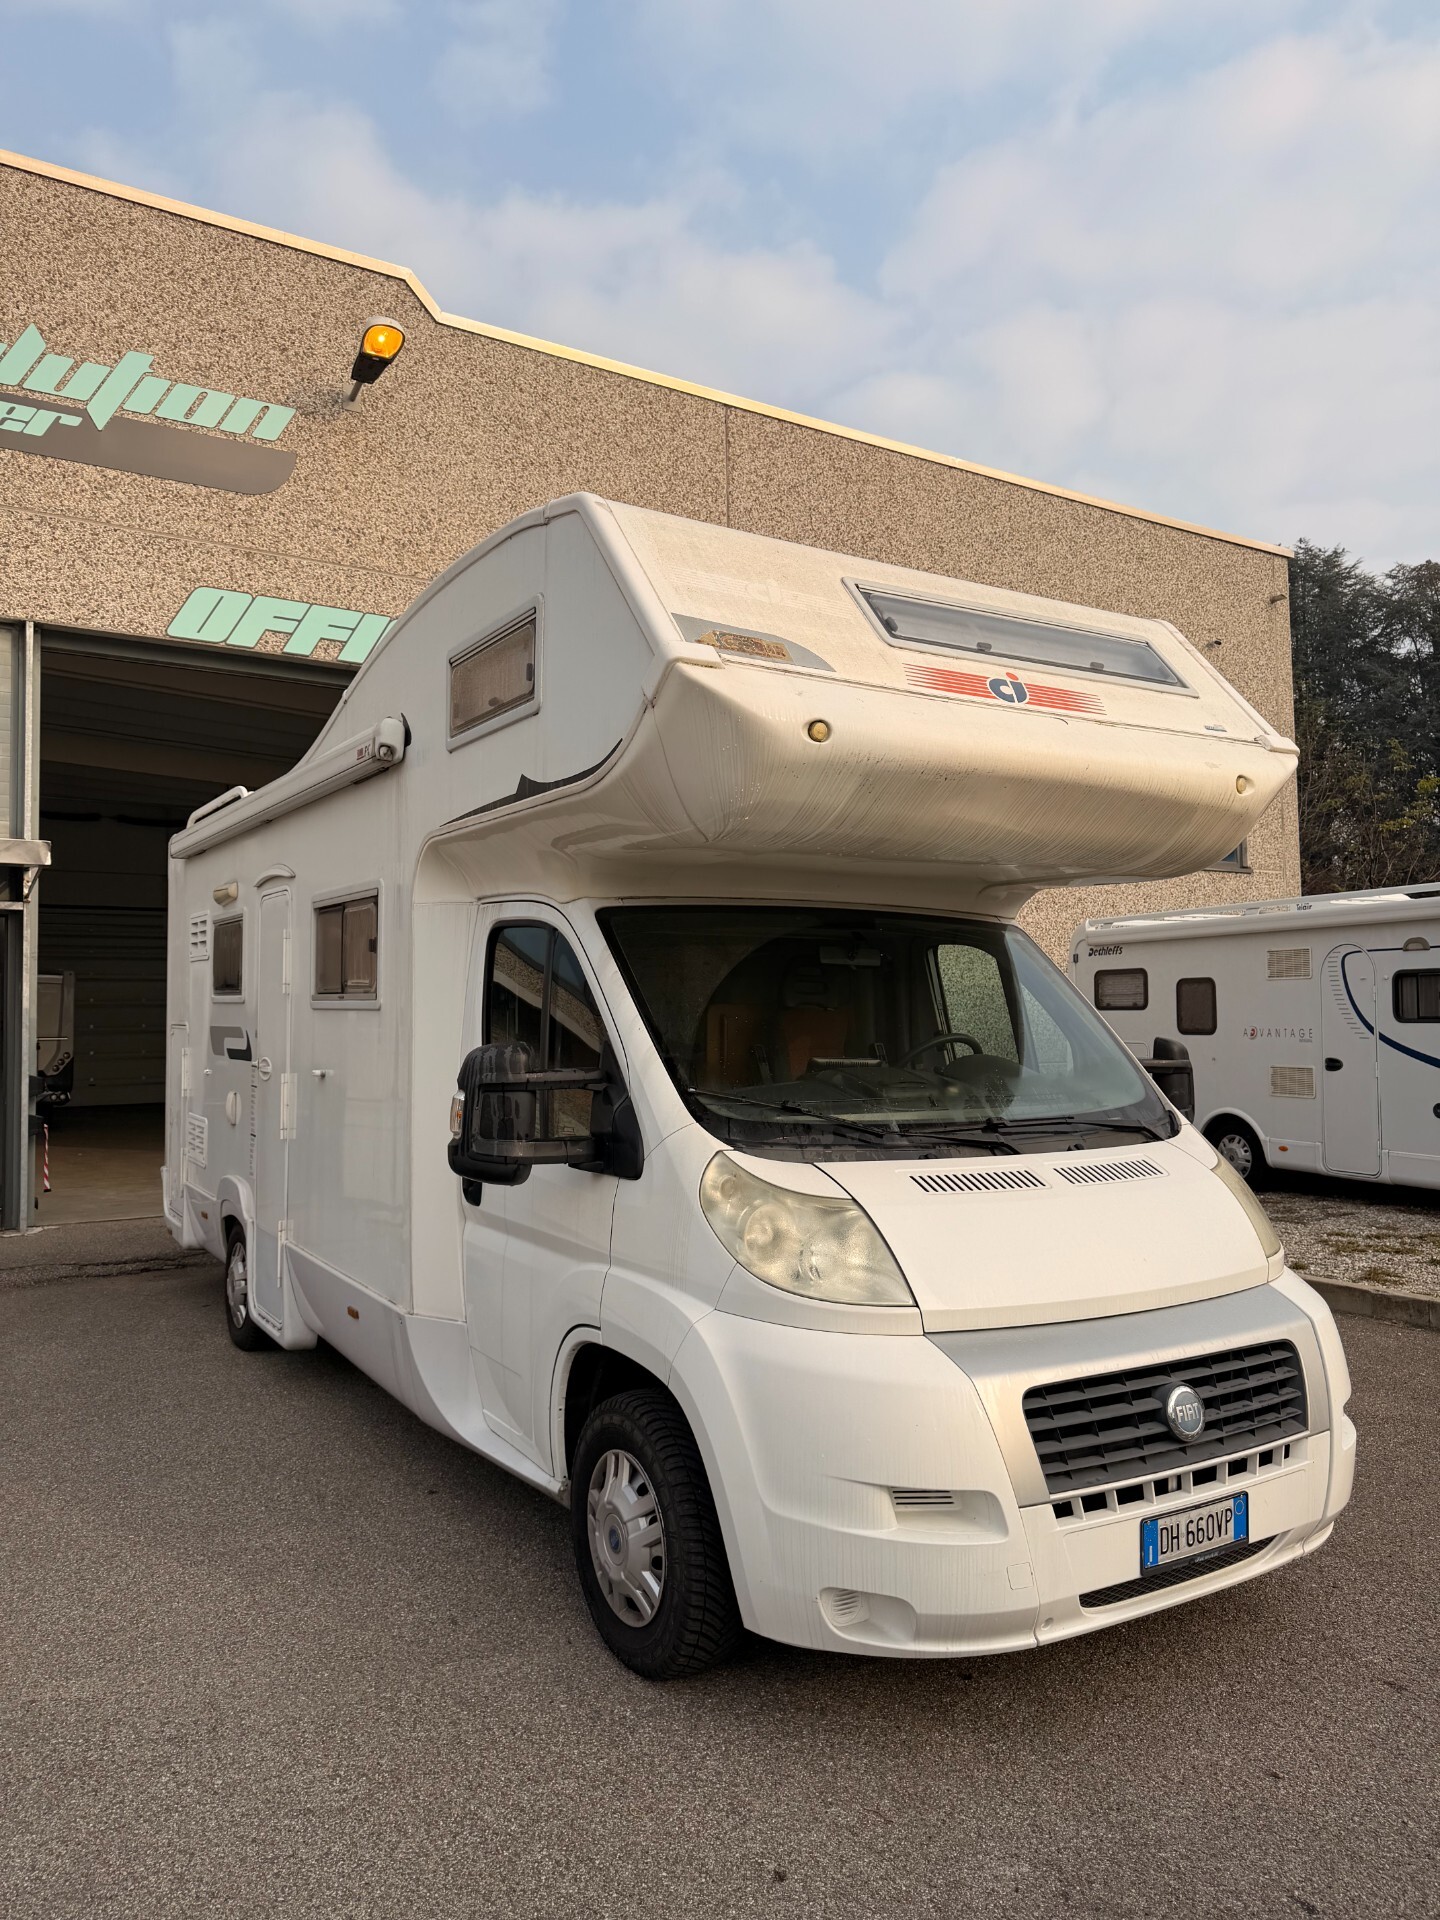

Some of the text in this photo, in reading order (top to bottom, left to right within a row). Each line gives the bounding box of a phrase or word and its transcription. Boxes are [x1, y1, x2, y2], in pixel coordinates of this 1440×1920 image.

[0, 322, 296, 441] lution
[166, 586, 398, 664] OFFI
[1088, 946, 1123, 957] Dethleffs
[1243, 1026, 1313, 1040] ADVANTAGE
[1175, 1402, 1199, 1423] FIAT
[1160, 1524, 1180, 1555] DH
[1186, 1508, 1233, 1548] 660VP
